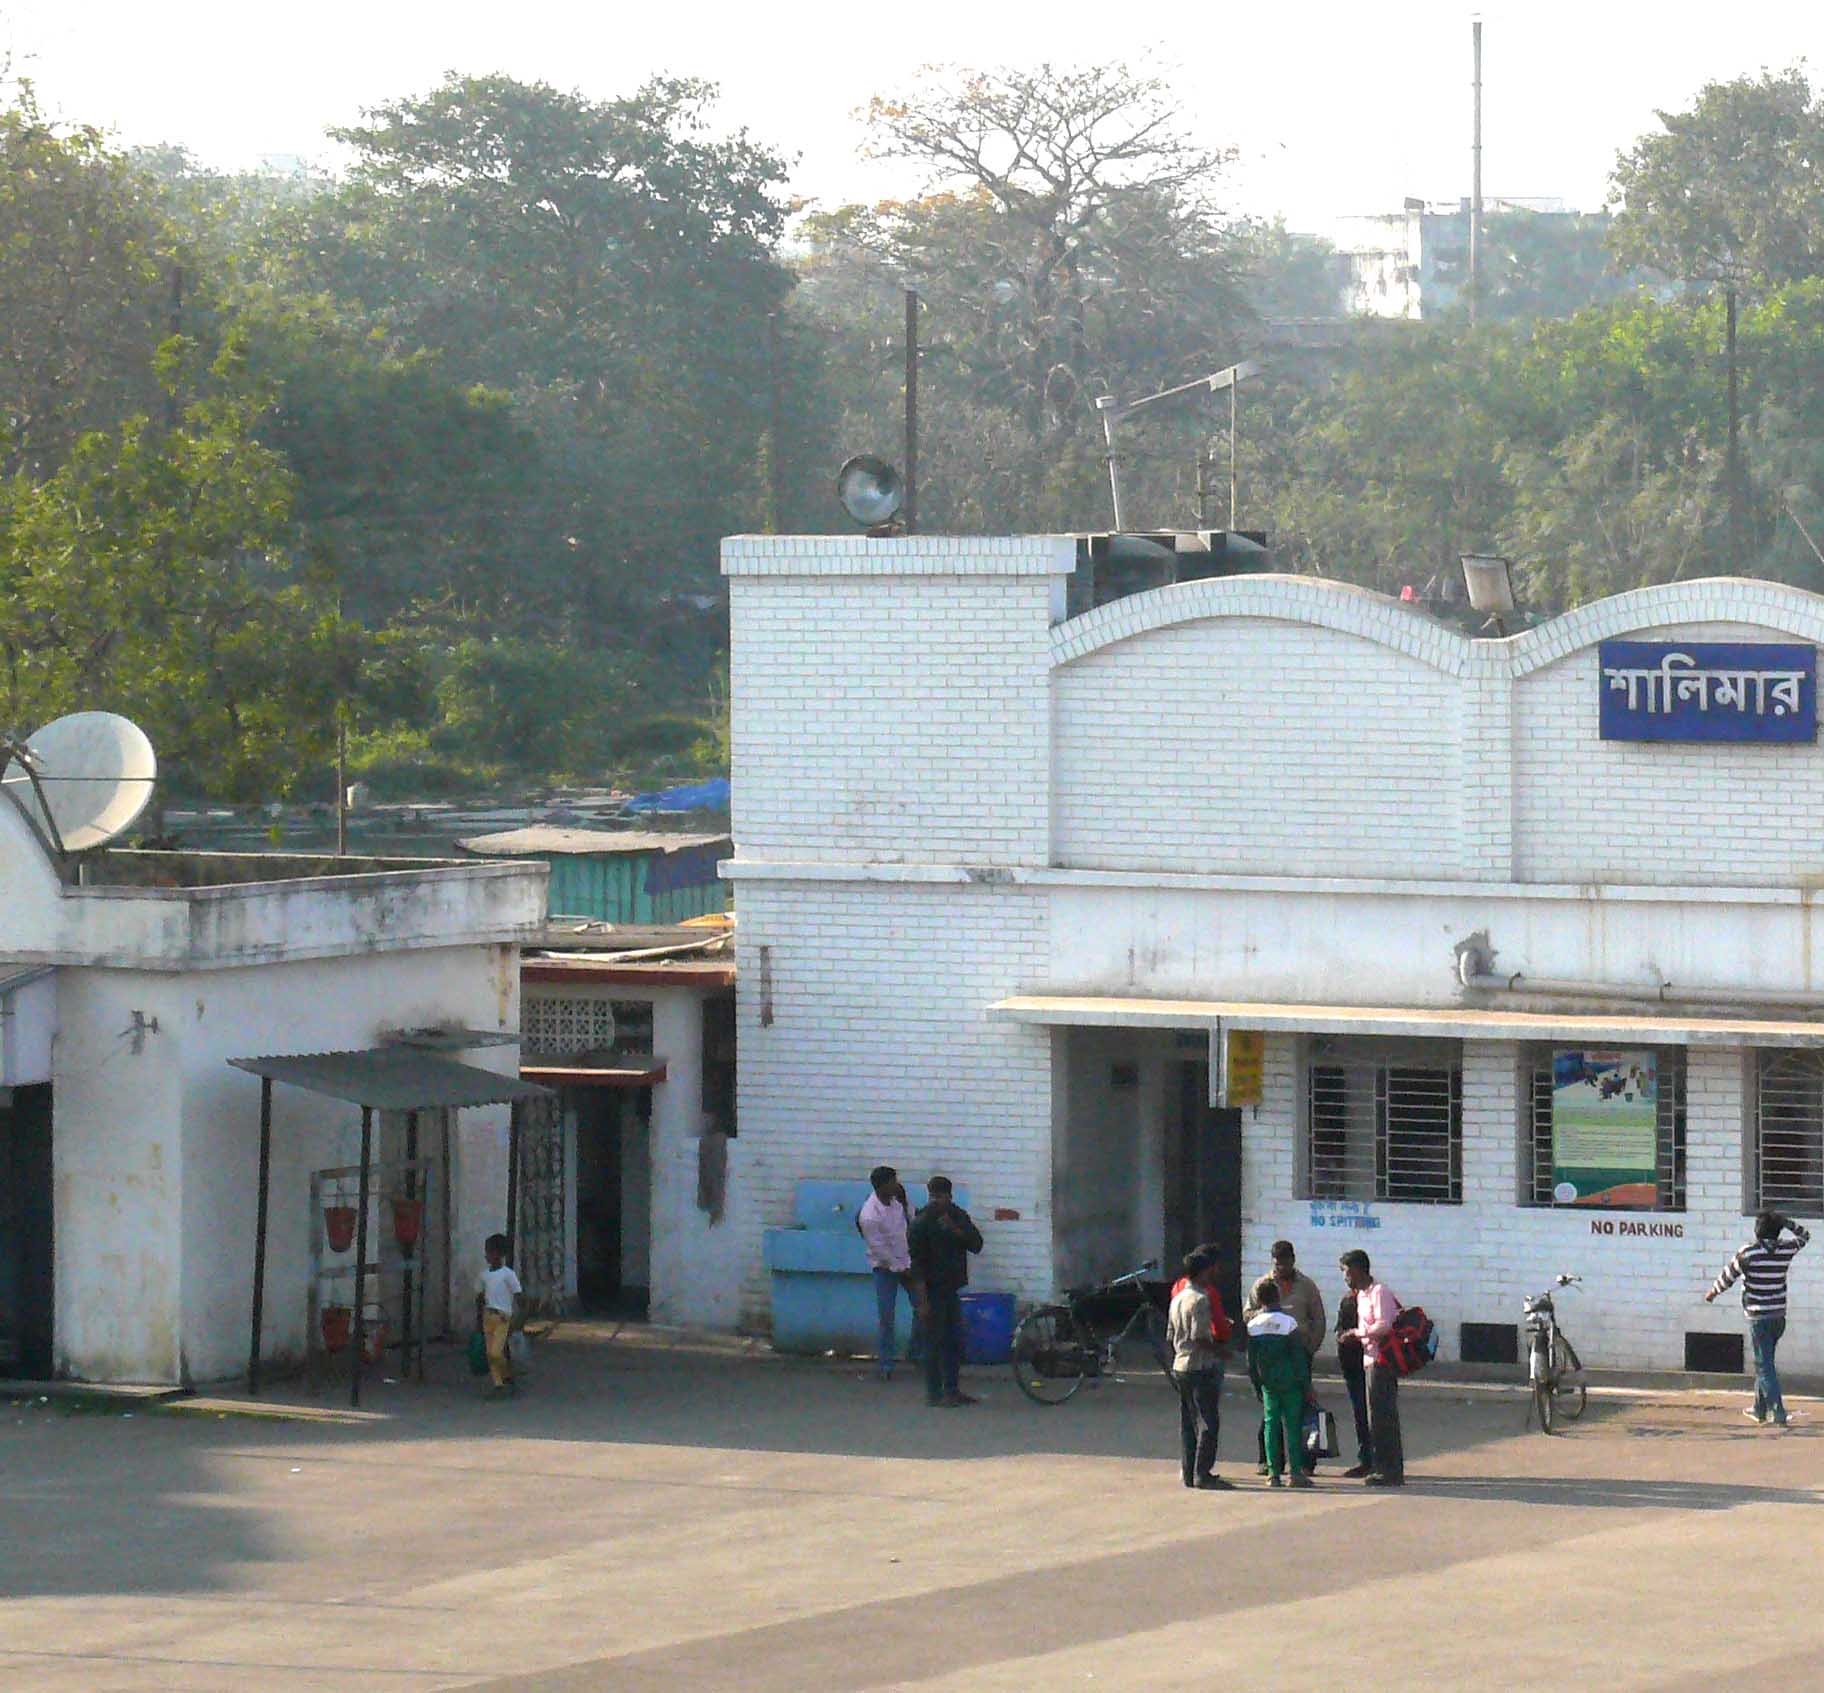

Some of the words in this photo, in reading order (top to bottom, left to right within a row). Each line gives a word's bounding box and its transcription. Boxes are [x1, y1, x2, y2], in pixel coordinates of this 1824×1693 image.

[1604, 653, 1805, 716] শালিমার
[1310, 1215, 1326, 1228] NO
[1591, 1221, 1614, 1235] NO
[1619, 1221, 1684, 1238] PARKING
